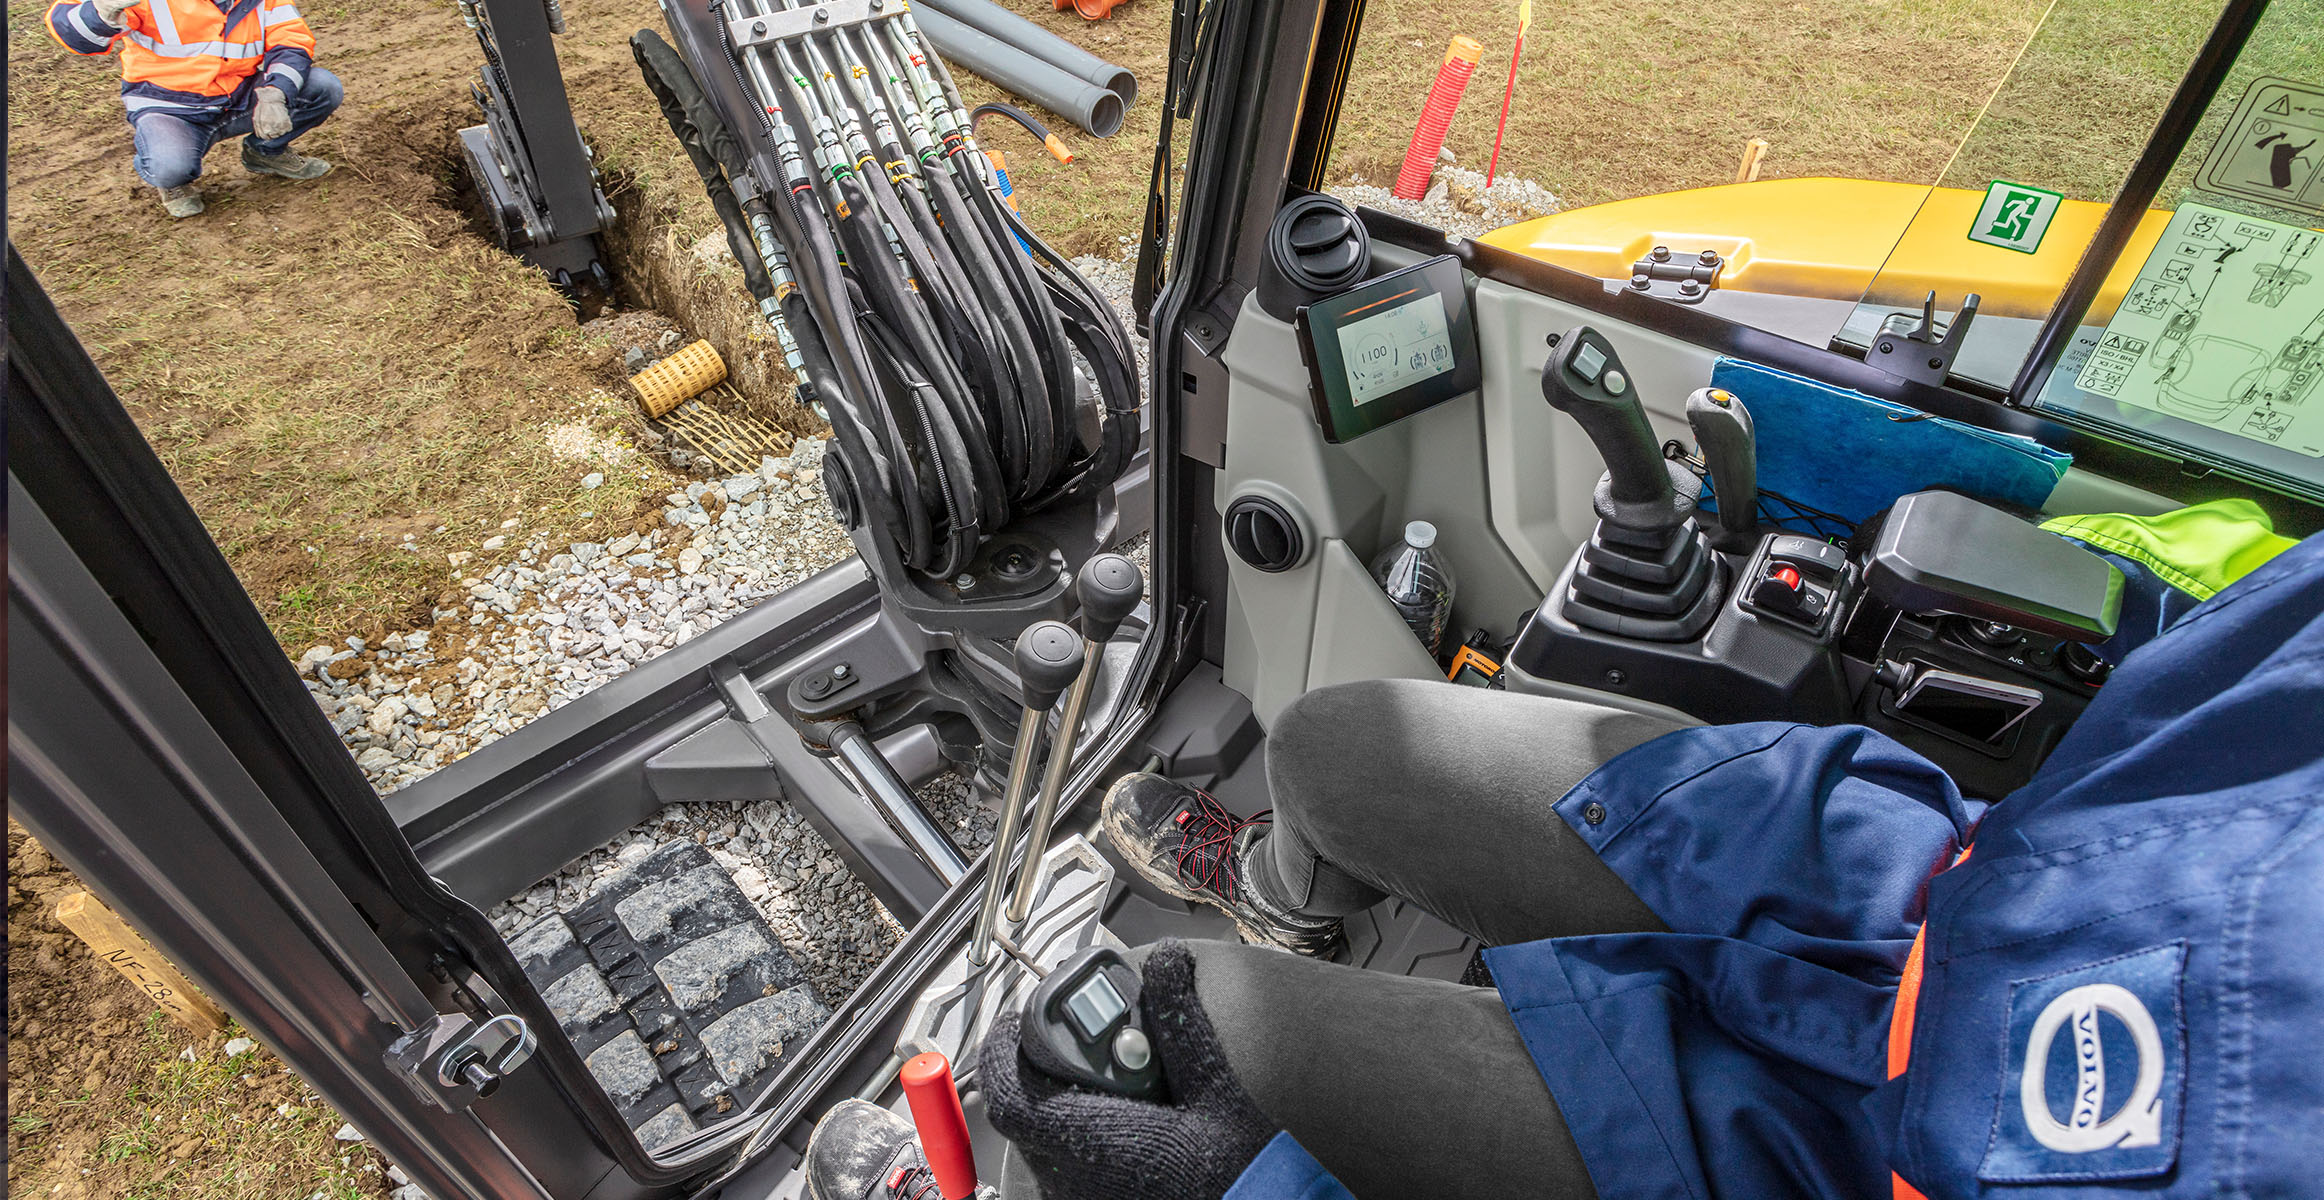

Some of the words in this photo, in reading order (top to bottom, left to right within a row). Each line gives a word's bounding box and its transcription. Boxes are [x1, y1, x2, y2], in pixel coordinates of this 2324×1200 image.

[1361, 345, 1387, 364] 1100
[2008, 656, 2024, 665] A/C
[2077, 1012, 2098, 1128] VOLVO
